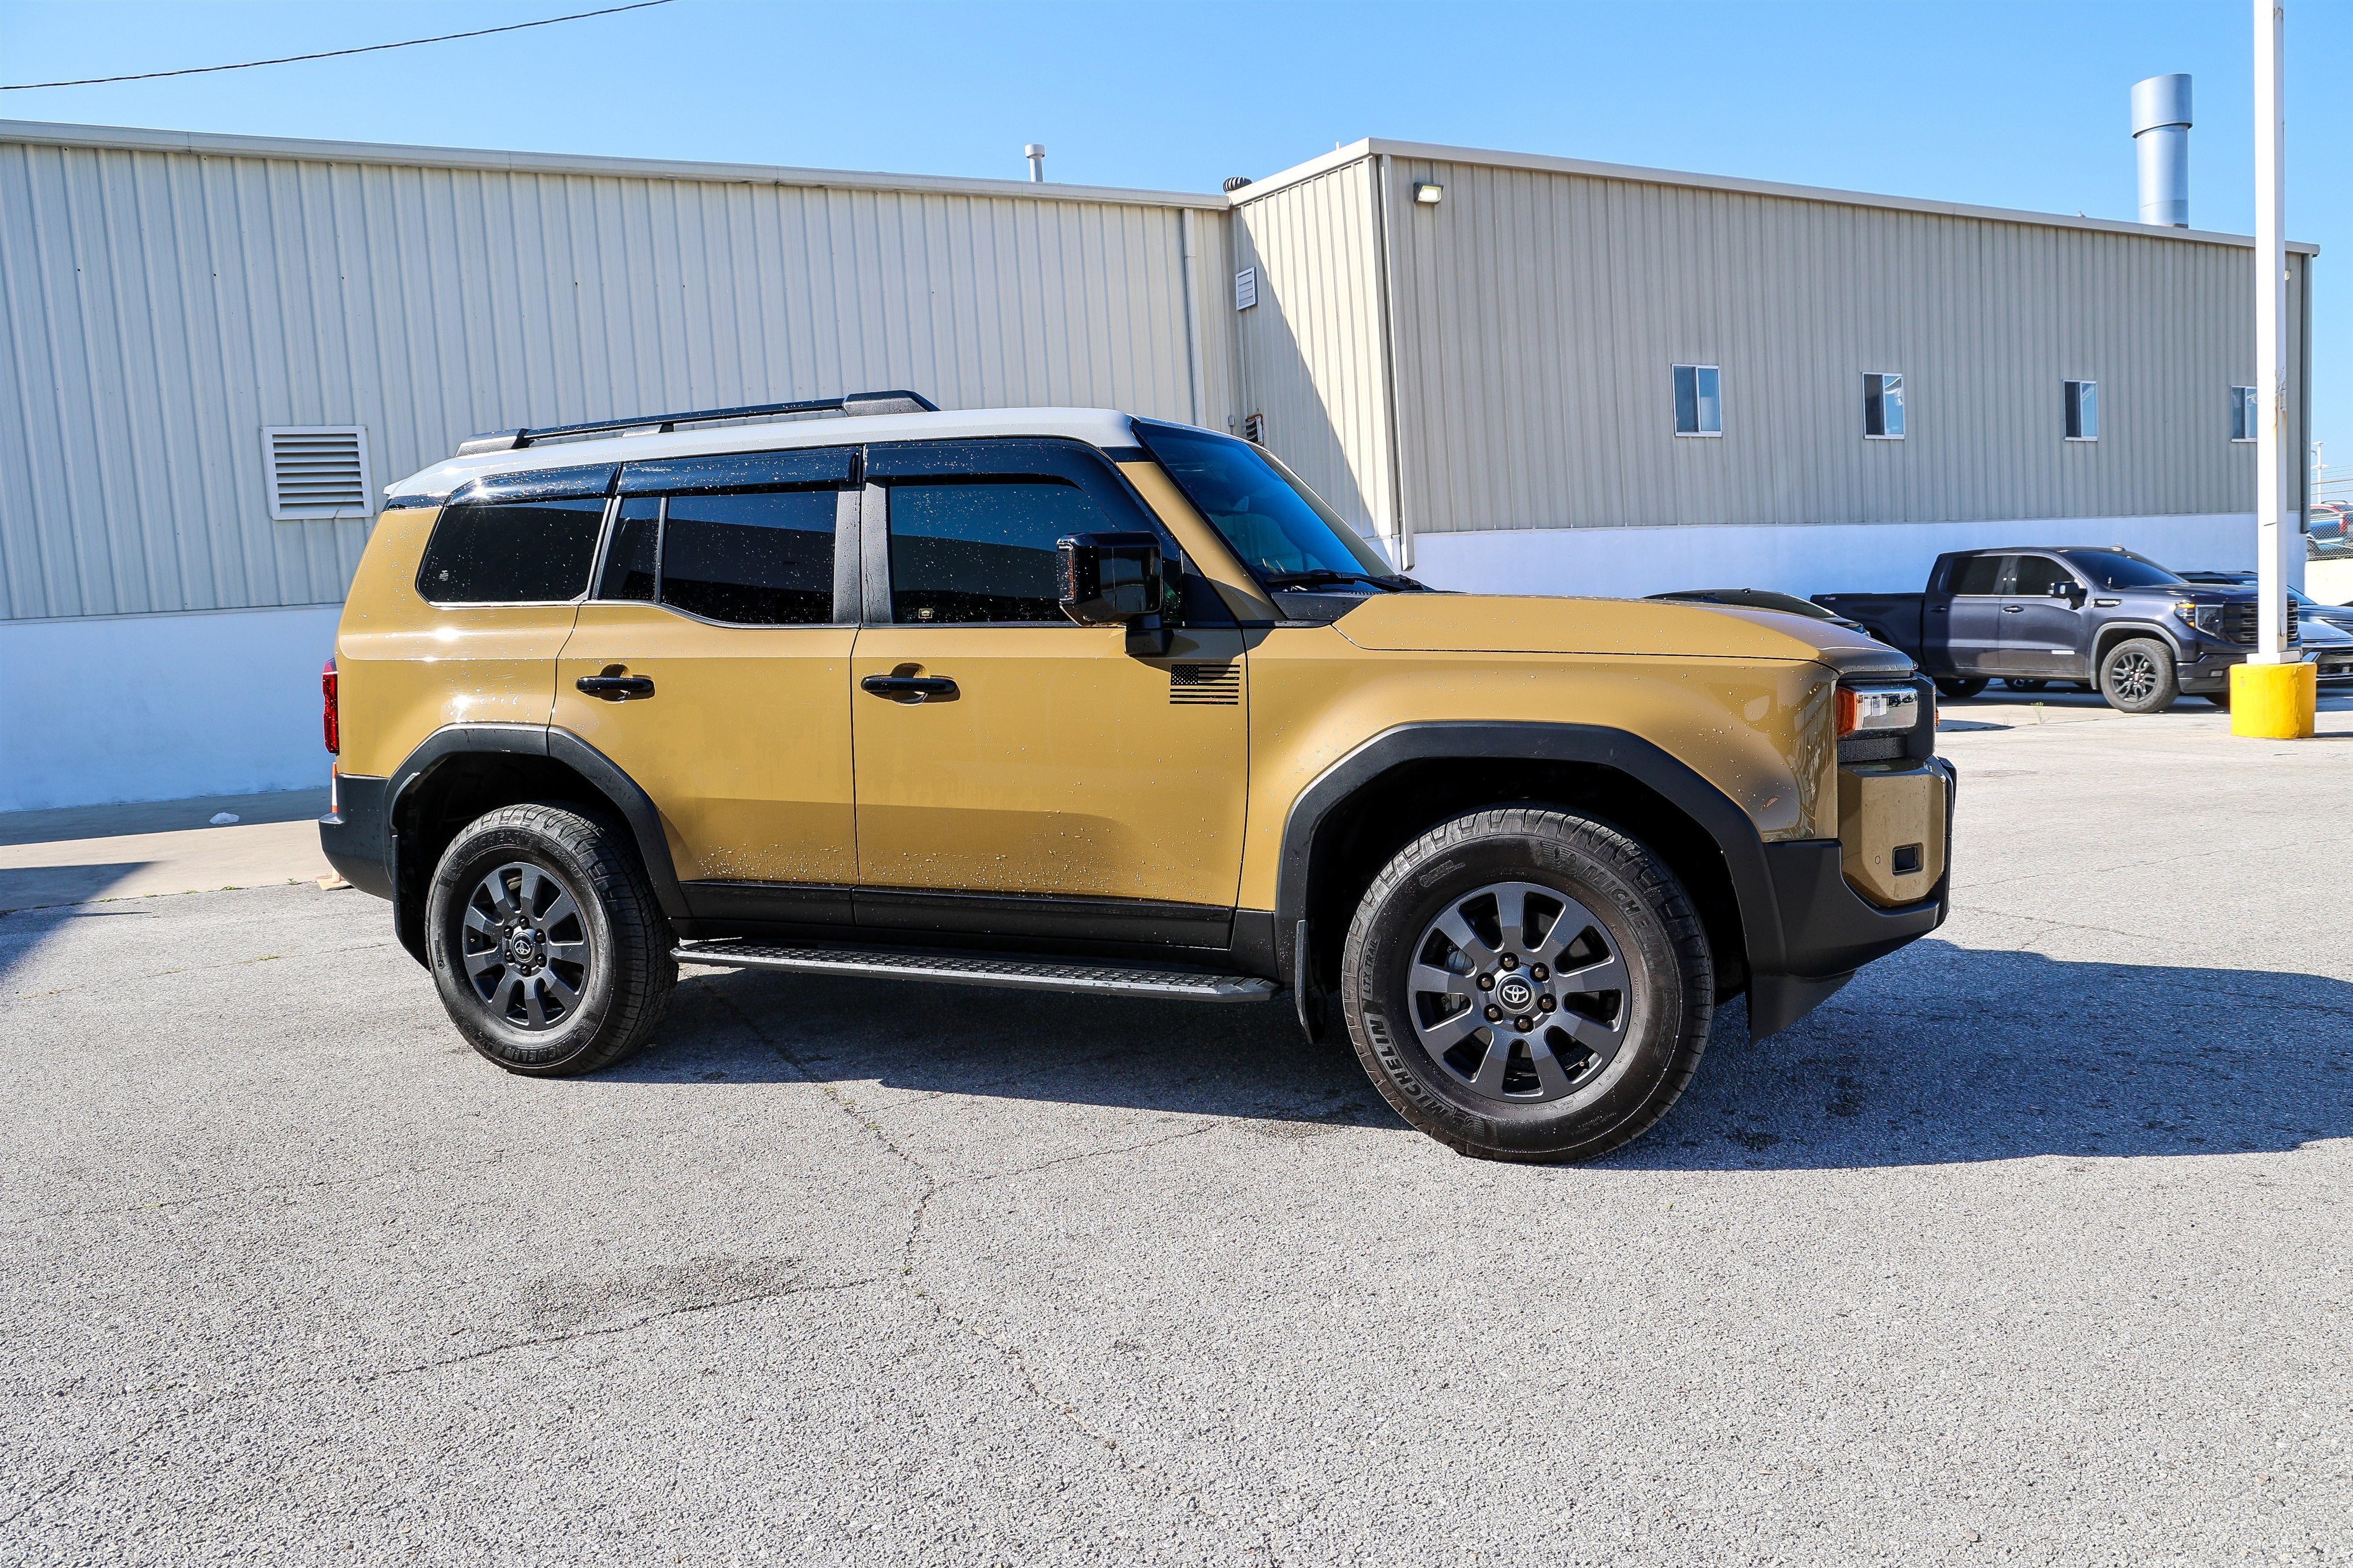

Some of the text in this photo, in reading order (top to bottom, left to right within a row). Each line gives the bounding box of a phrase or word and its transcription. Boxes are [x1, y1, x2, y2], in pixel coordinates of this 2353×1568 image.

[1363, 939, 1379, 994] LTX TRAIL
[1370, 1018, 1449, 1118] MICHELIN
